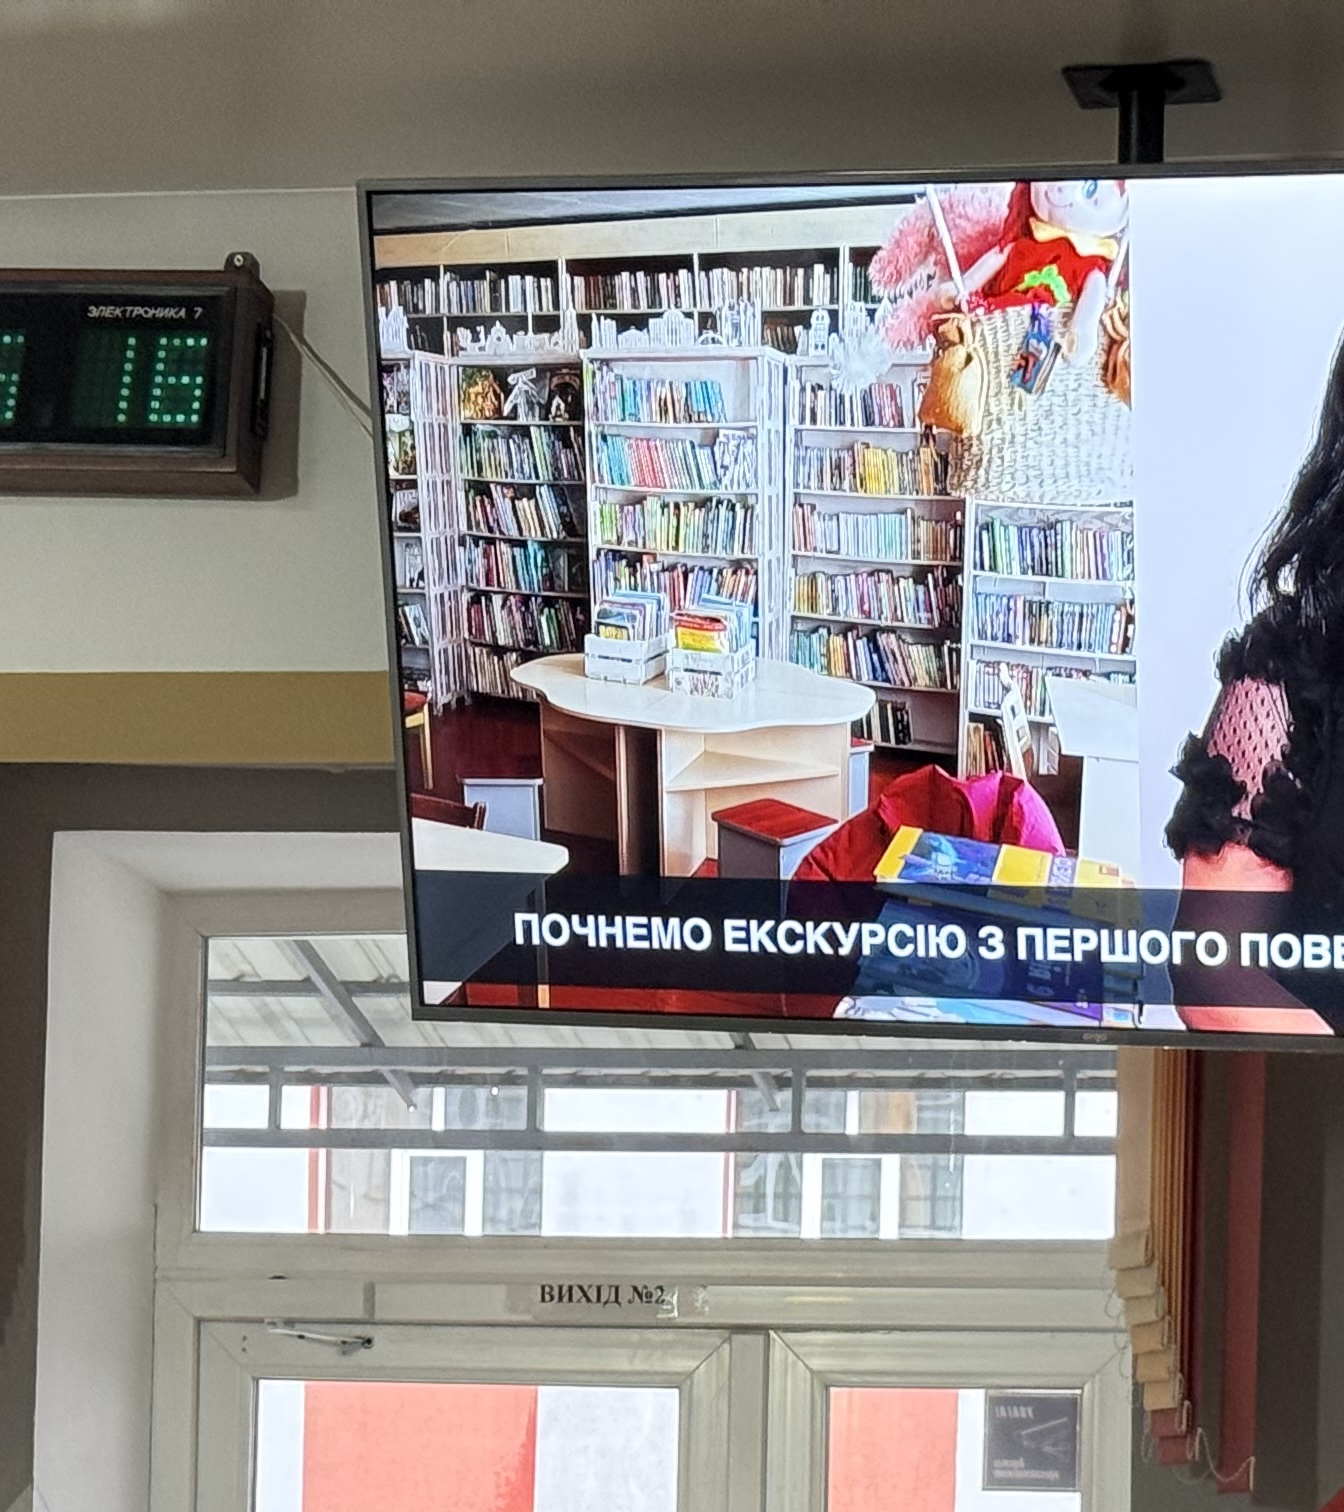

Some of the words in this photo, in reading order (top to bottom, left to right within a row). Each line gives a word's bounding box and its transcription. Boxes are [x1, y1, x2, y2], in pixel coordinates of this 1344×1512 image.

[87, 305, 186, 320] ЭЛЕКТРОНИКА
[193, 306, 203, 320] 7
[117, 336, 209, 423] 16
[514, 912, 712, 951] ПОЧНЕМО
[723, 919, 967, 959] ЕКСКУРСІЮ
[978, 925, 1005, 960] З
[1017, 927, 1228, 966] ПЕРШОГО
[540, 1284, 623, 1308] ВИХІД
[627, 1284, 667, 1305] №2
